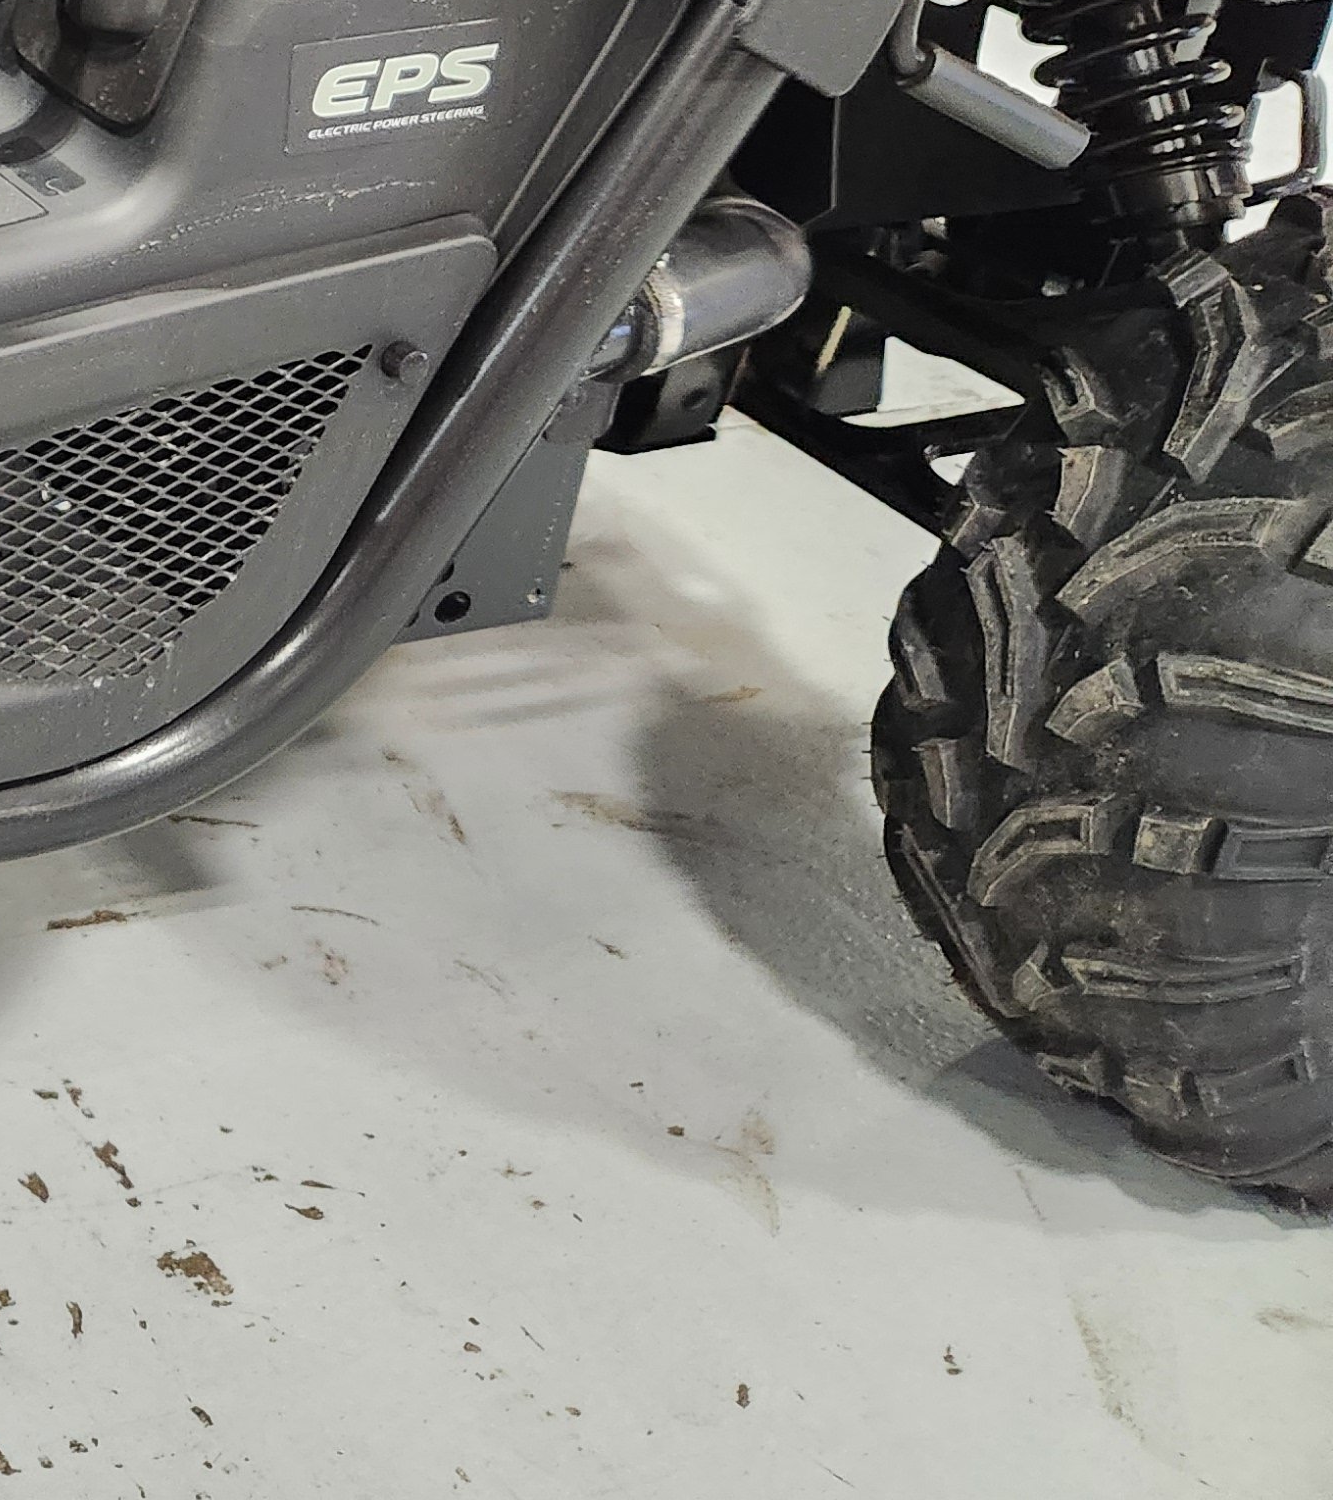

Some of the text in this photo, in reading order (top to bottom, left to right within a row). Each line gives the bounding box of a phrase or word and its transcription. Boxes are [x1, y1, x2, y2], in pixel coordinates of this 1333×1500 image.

[312, 43, 500, 118] EPS
[308, 104, 487, 140] ELECTRIC POWER STEERING
